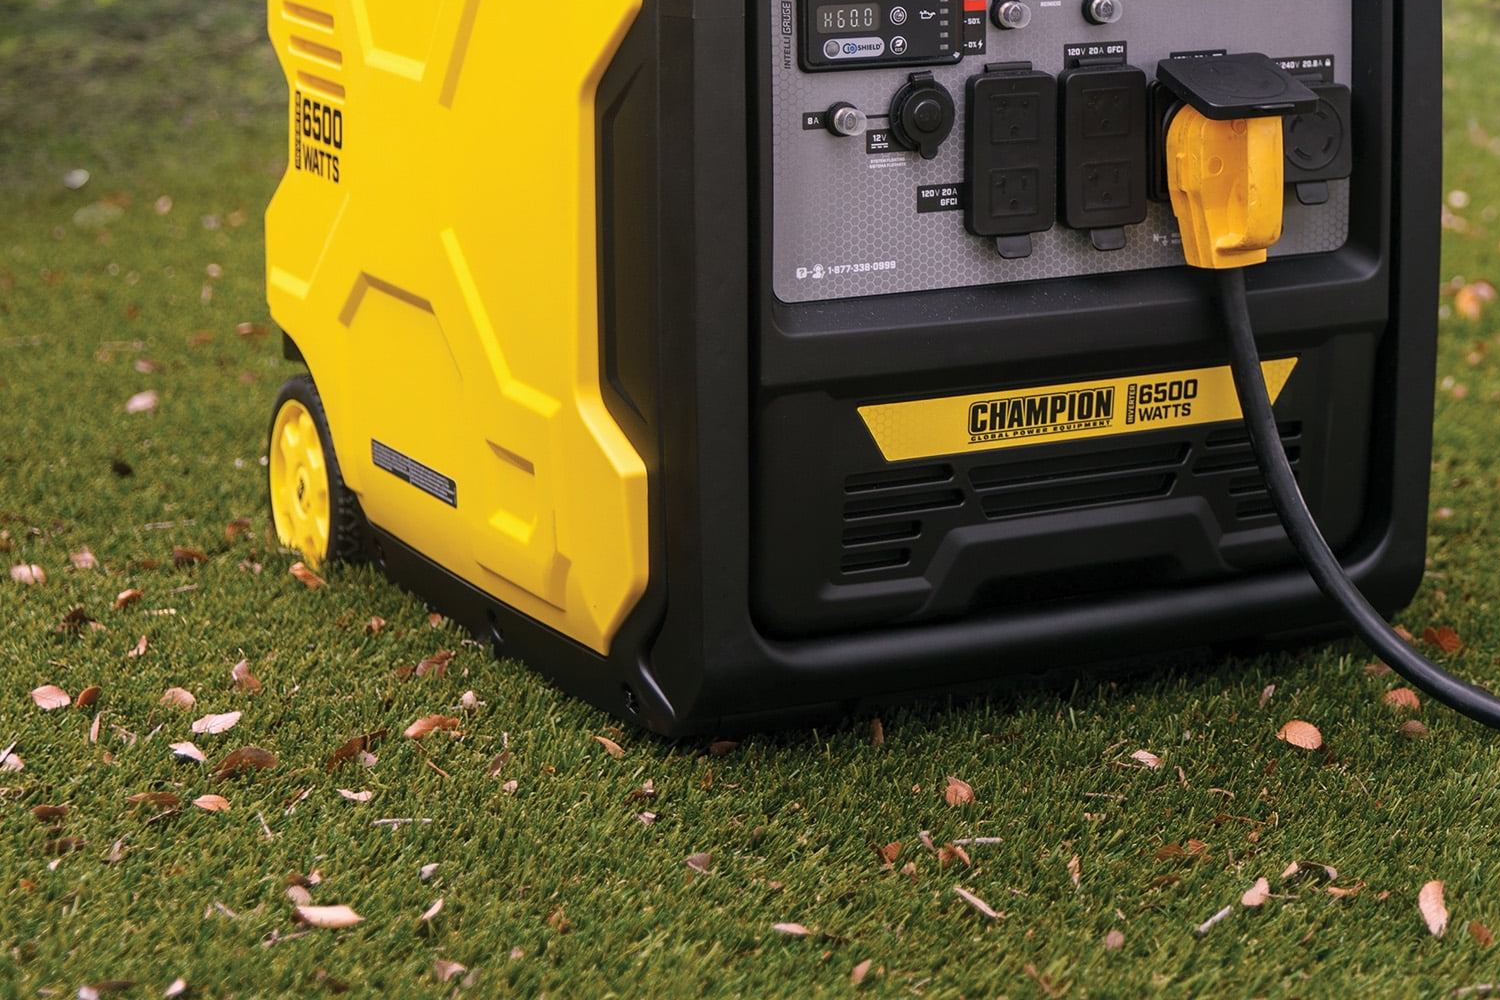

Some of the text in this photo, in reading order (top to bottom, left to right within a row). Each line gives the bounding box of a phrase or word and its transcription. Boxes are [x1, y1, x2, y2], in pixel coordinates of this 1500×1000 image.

[783, 1, 792, 70] INTELLI GAUGE
[857, 43, 881, 51] SHIELD
[1107, 46, 1124, 54] GFCI
[303, 98, 343, 150] 6500
[872, 134, 887, 142] 12V
[303, 143, 340, 183] WATTS
[940, 198, 958, 206] GFCI
[1138, 378, 1199, 404] 6500
[971, 389, 1113, 433] CHAMPION
[1127, 384, 1136, 424] INVERTER
[1138, 402, 1192, 422] WATTS
[970, 420, 1111, 442] GLOBAL POWER EQUIPMENT
